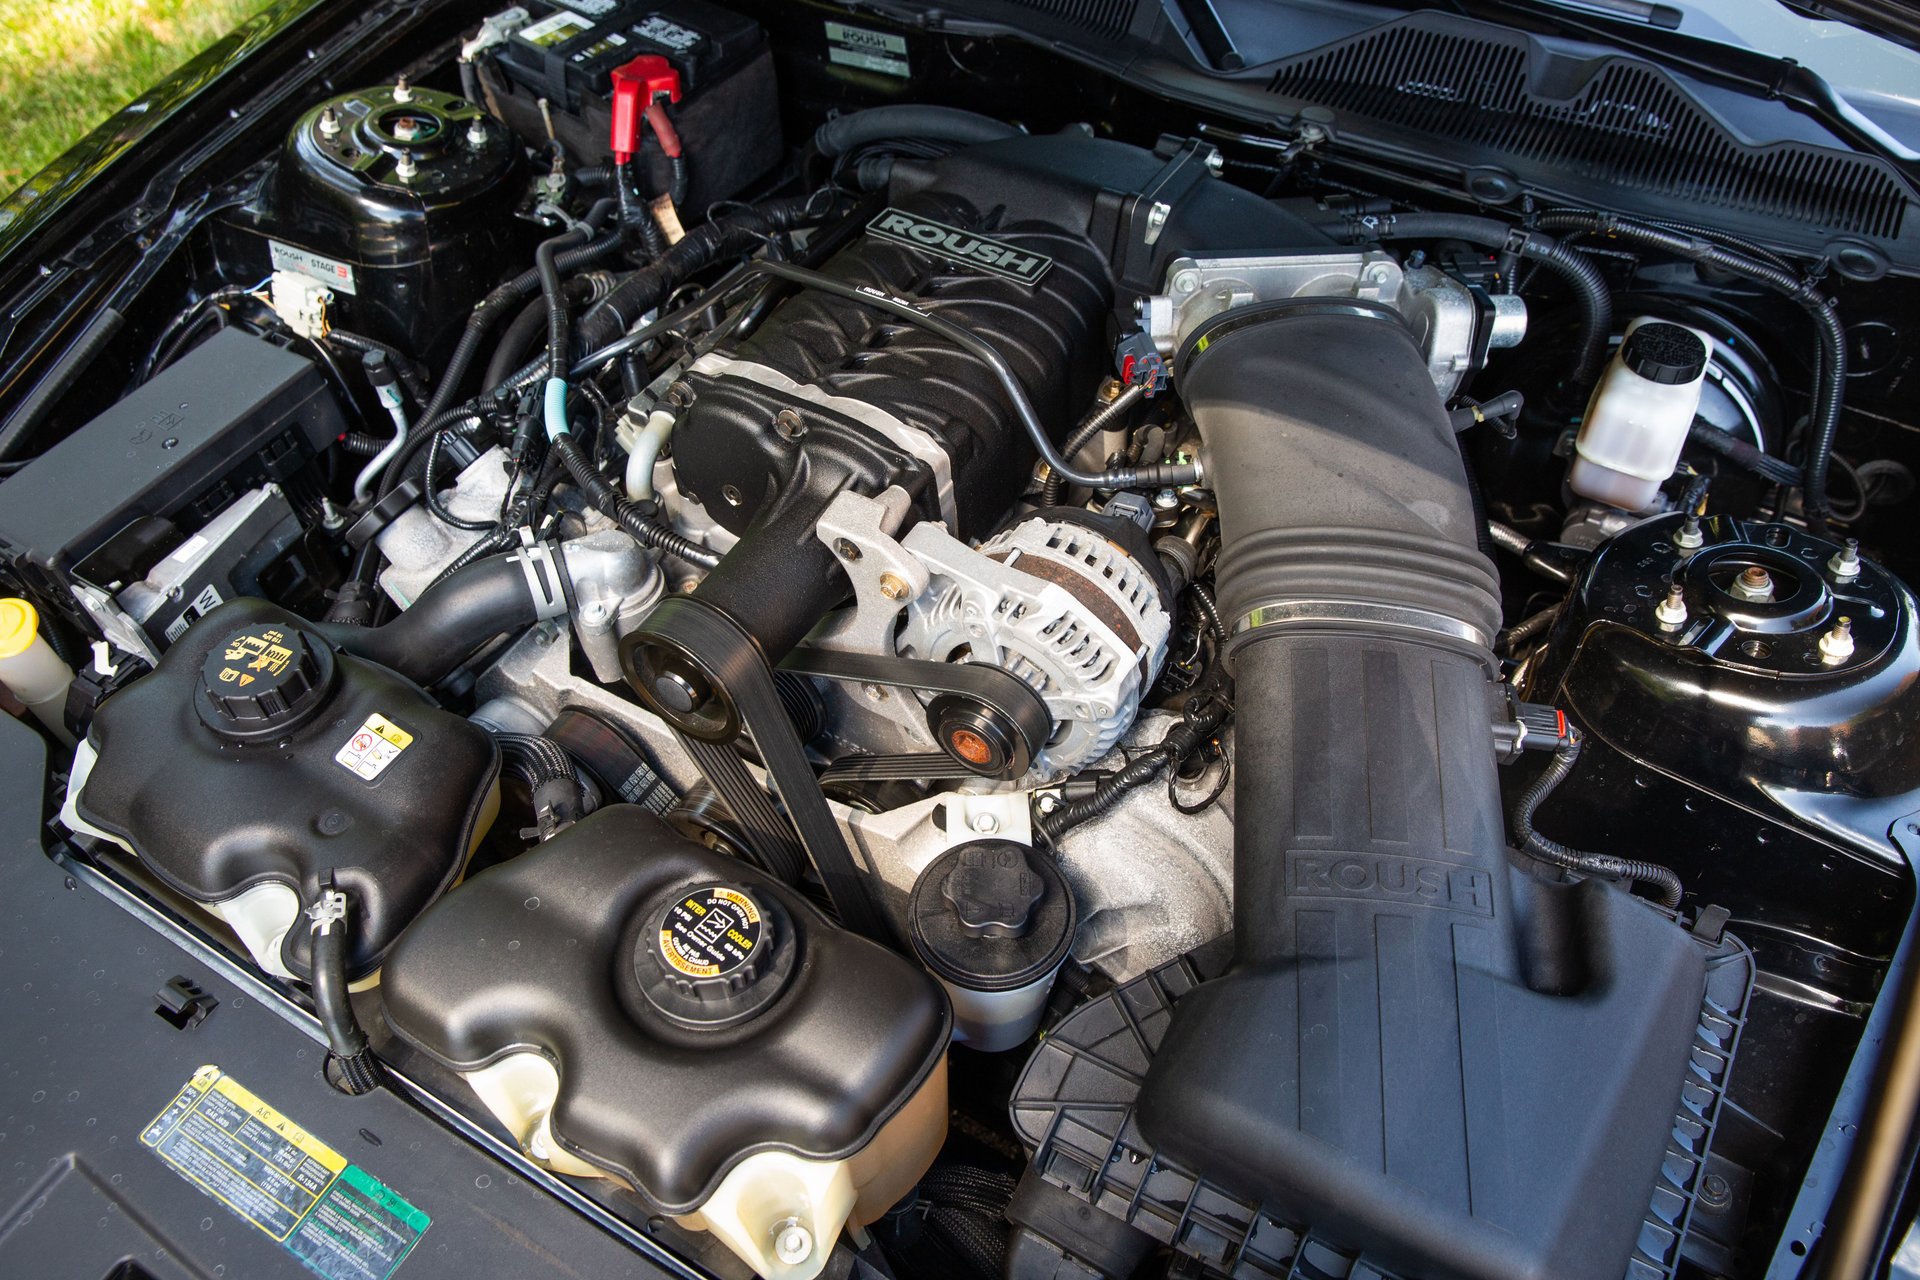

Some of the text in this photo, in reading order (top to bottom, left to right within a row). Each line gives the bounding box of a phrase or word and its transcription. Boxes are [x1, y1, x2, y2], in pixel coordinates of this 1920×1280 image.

[878, 213, 1039, 275] ROUSH
[274, 247, 303, 262] ROUSH
[311, 259, 336, 274] STAGE
[336, 265, 348, 278] 3
[1295, 858, 1486, 908] ROUSH
[685, 899, 707, 917] INTER
[718, 899, 732, 907] NOT
[731, 904, 746, 918] OPEN
[727, 892, 757, 919] WARNING
[675, 922, 726, 962] See Owner Guide
[727, 929, 753, 950] COOLER
[663, 939, 713, 975] AVERTISSEMENT
[204, 1107, 218, 1119] SAE
[255, 1105, 271, 1119] A/C
[295, 1172, 318, 1192] R-134A
